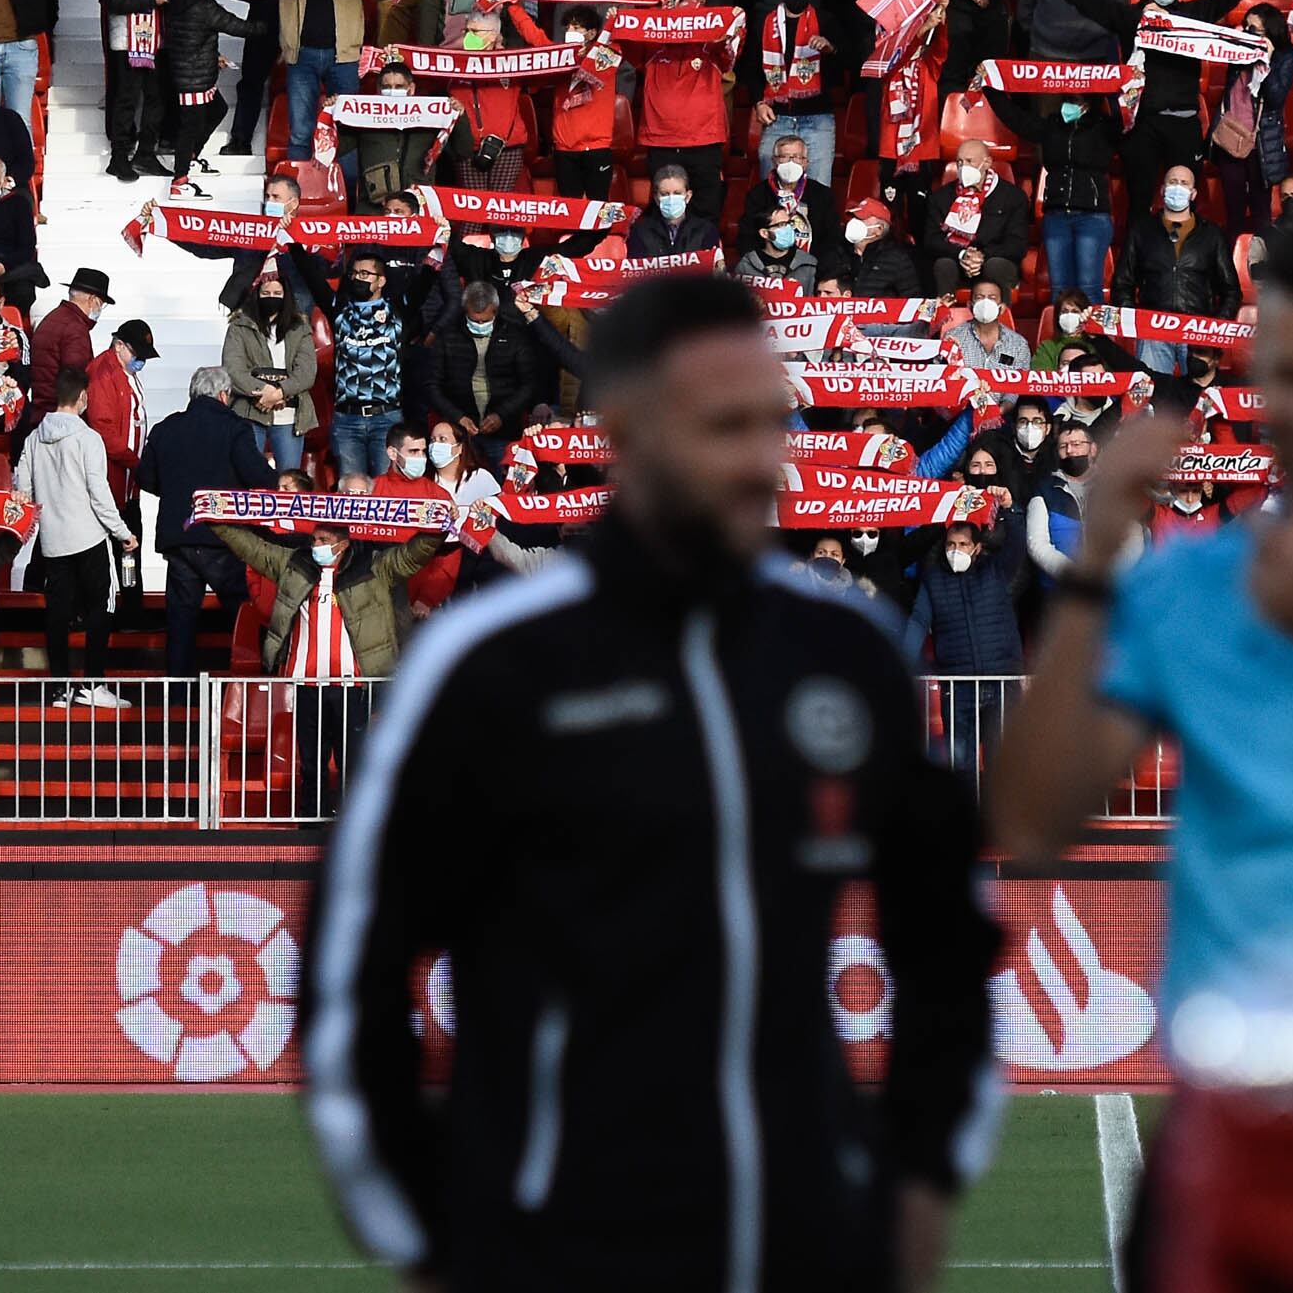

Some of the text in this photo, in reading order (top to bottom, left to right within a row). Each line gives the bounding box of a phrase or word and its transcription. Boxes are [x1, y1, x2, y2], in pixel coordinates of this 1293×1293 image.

[1012, 63, 1121, 81] UD ALMERÍA
[1042, 80, 1091, 88] 2001-2021
[795, 496, 921, 515] UD ALMERÍA
[828, 514, 885, 523] 2001-2021
